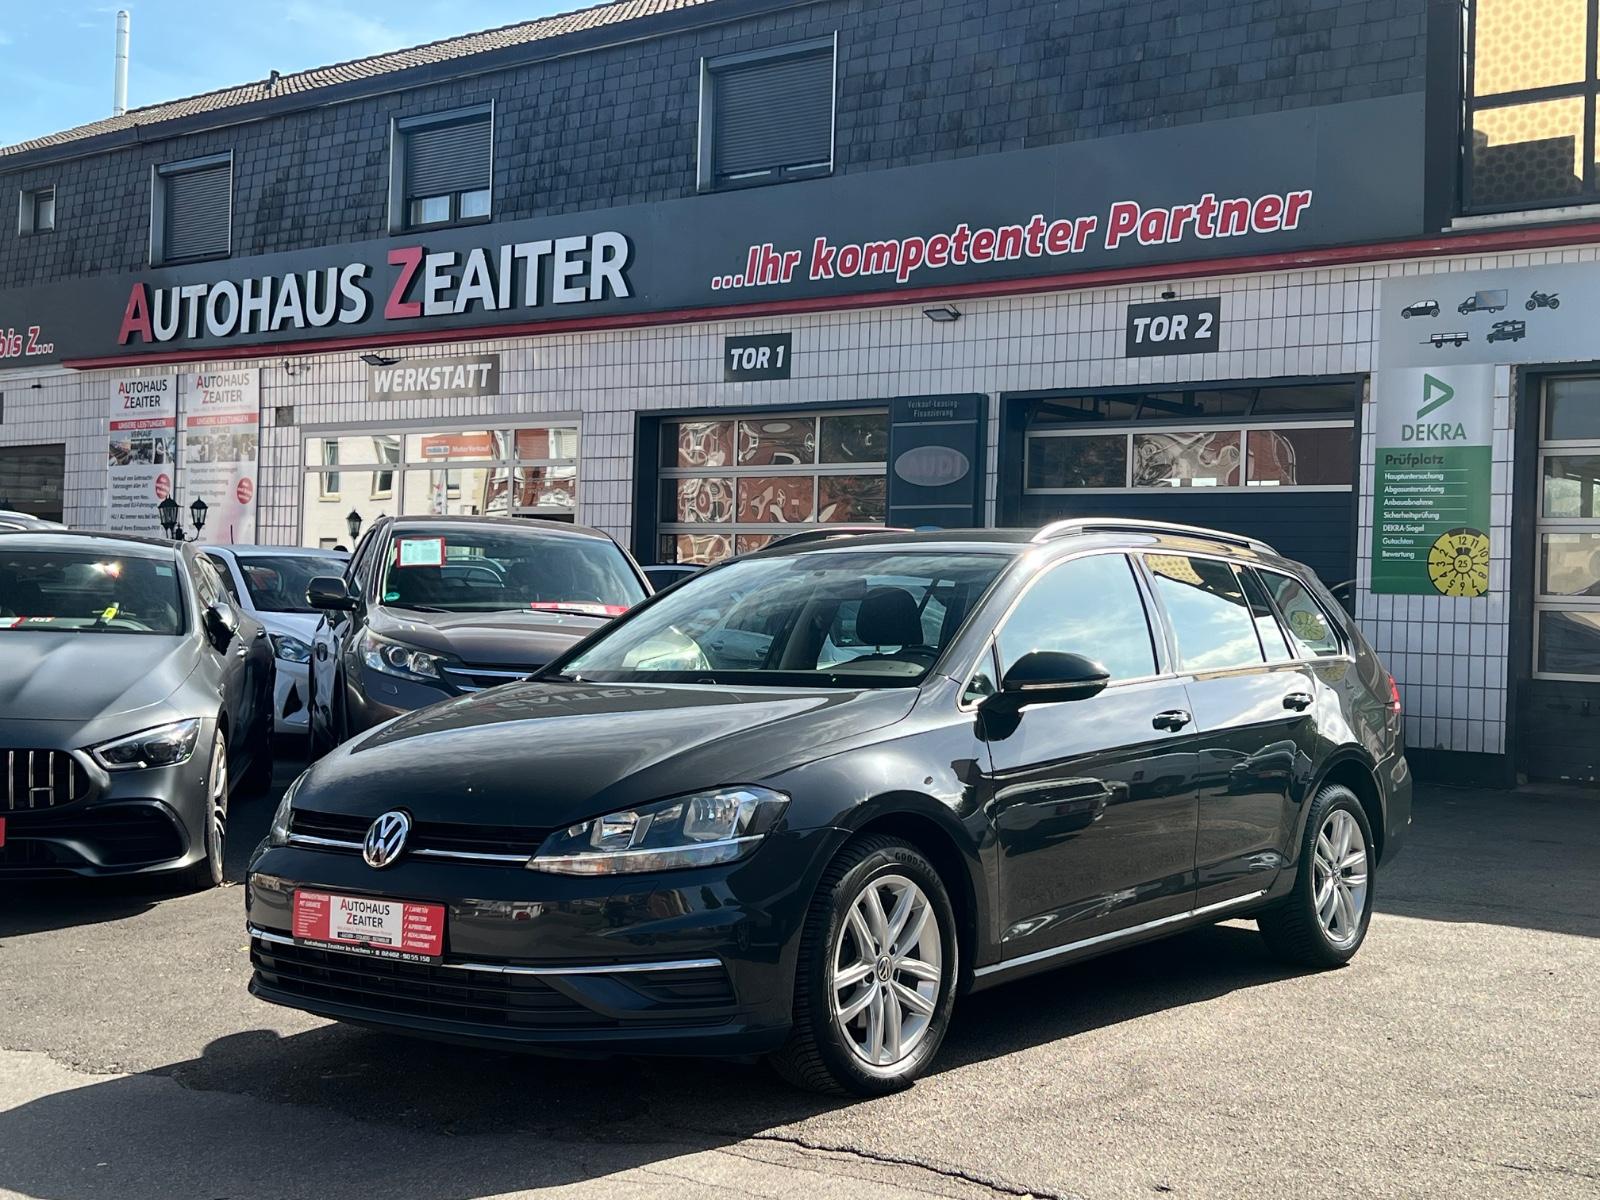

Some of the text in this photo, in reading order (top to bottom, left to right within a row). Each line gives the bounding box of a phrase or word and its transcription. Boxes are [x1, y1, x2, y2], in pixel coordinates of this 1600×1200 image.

[809, 214, 1097, 282] kompetenter
[1104, 189, 1313, 250] Partner
[118, 231, 630, 346] AUTOHAUS ZEAITER
[1133, 312, 1214, 344] TOR 2
[730, 345, 785, 371] TOR 1
[196, 373, 250, 389] AUTOHAUS
[373, 361, 493, 394] WERKSTATT
[118, 379, 168, 395] AUTOHAUS
[123, 395, 161, 409] ZEAITER
[202, 390, 243, 404] ZEAITER
[1401, 422, 1468, 441] DEKRA
[1385, 453, 1444, 468] Prüfplatz
[1384, 472, 1444, 481] Hauptuntersuchung
[1384, 485, 1445, 495] Abgasuntersuchung
[1383, 498, 1434, 506] Anbauabnahme
[1383, 511, 1440, 521] Sicherheitsprüfung
[1382, 524, 1425, 534] DEKRA-Siegel
[1382, 537, 1414, 545] Gutachten
[1458, 536, 1467, 546] 12
[1381, 551, 1415, 560] Bewertung
[1457, 559, 1468, 568] 25
[340, 898, 390, 916] AUTOHAUS
[346, 913, 384, 928] ZEAITER
